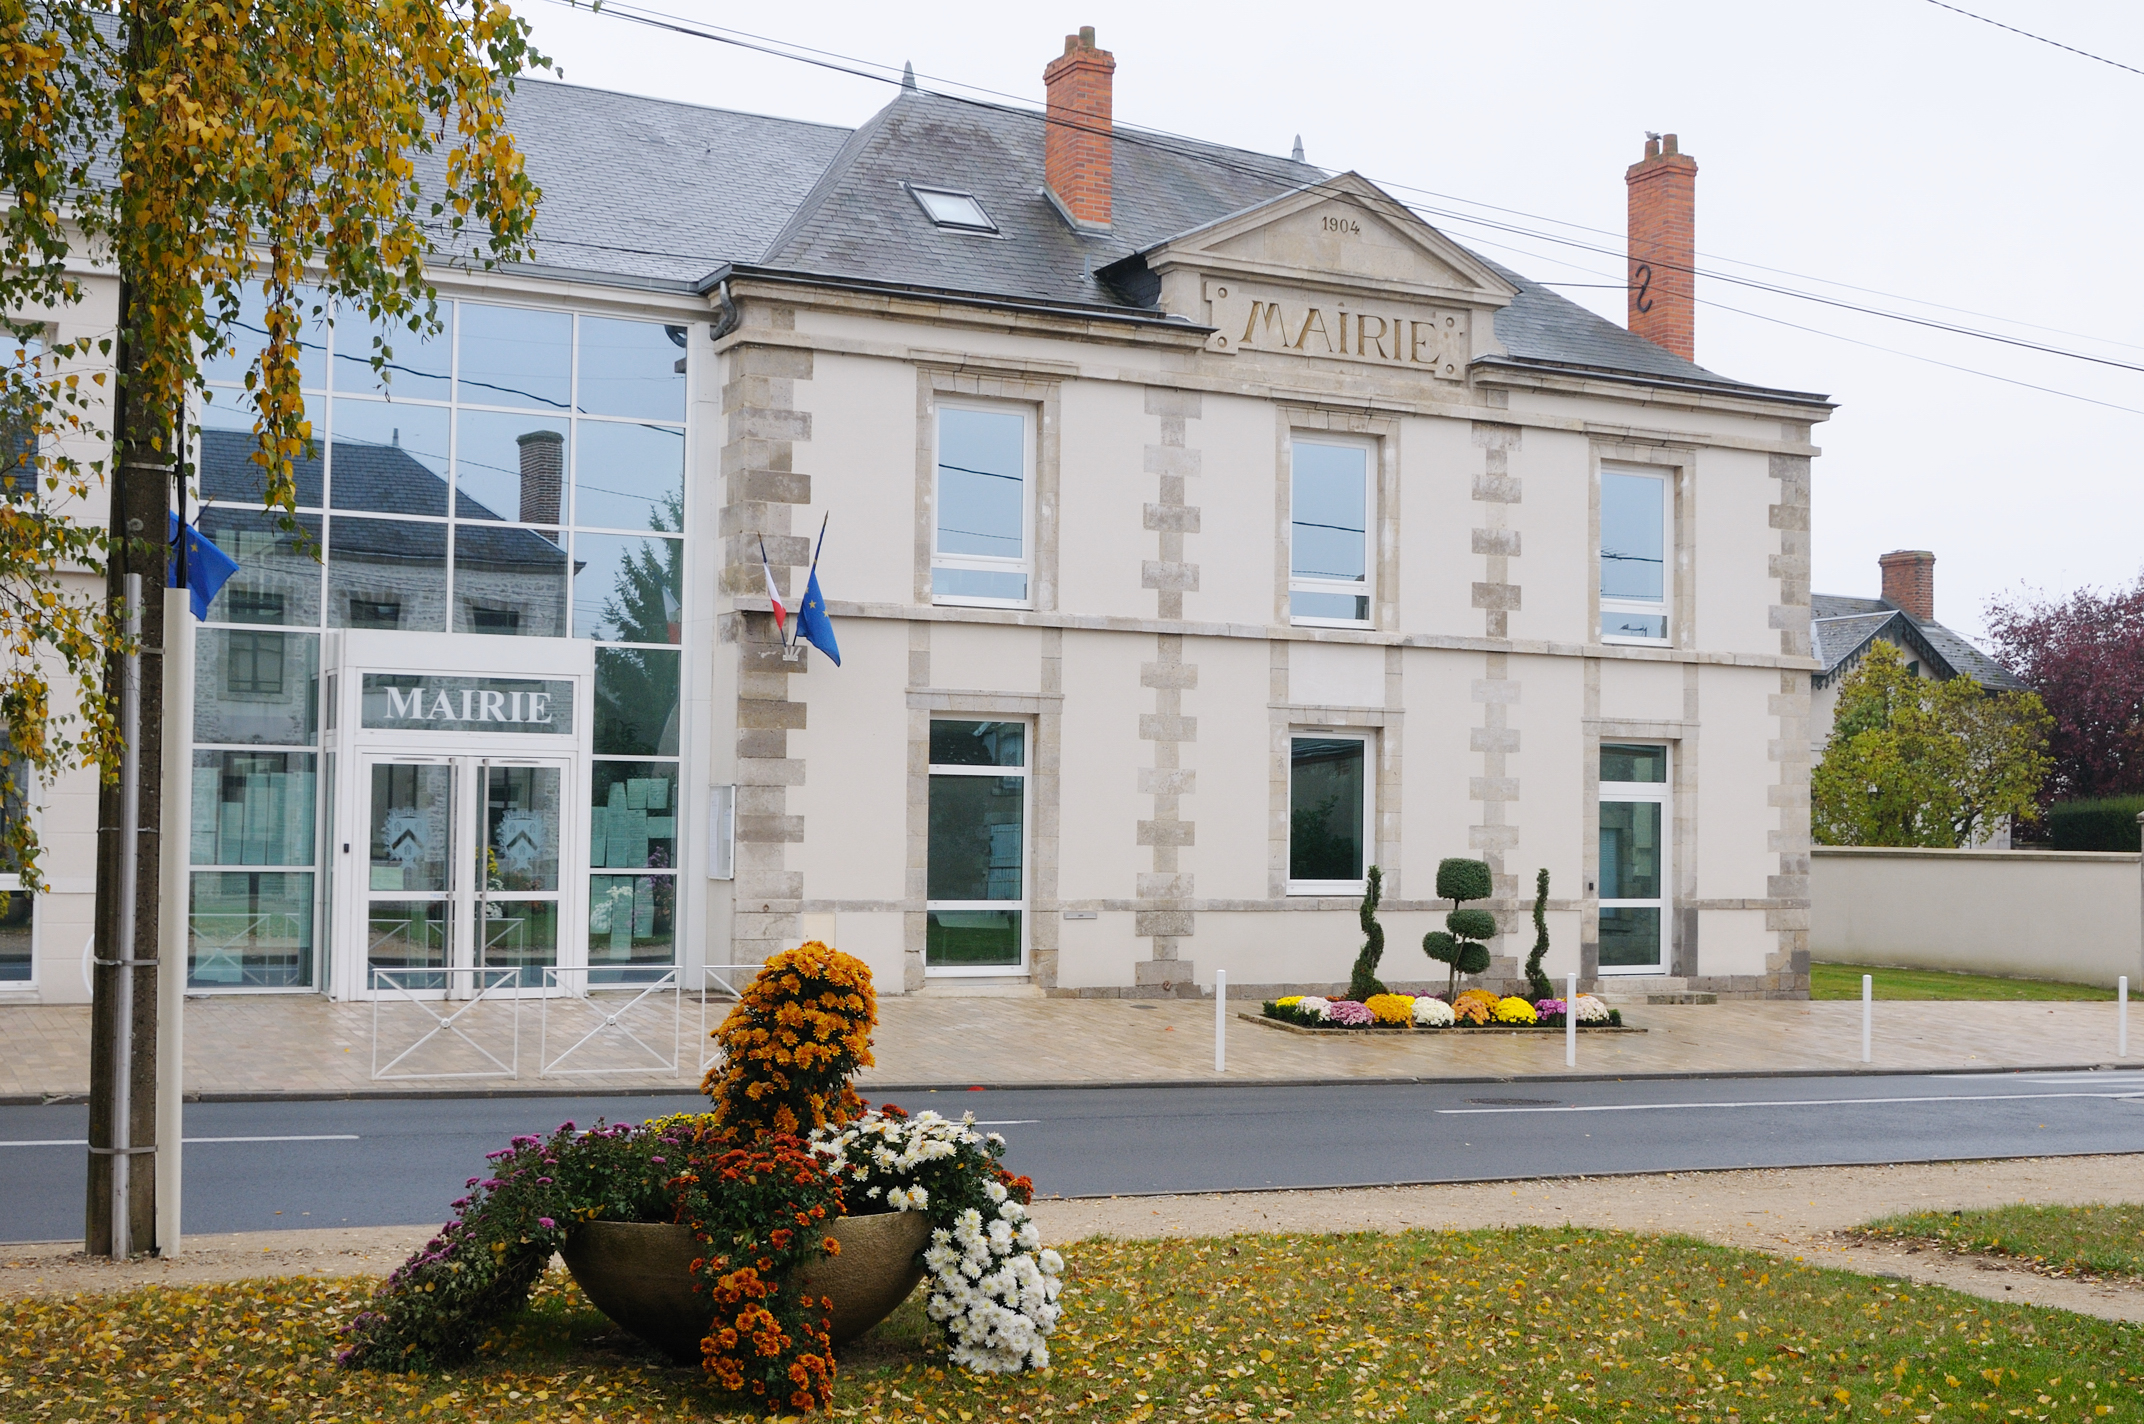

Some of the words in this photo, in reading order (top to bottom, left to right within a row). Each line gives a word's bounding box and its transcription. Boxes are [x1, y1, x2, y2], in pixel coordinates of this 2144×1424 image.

[1321, 216, 1360, 234] 1904
[1240, 300, 1440, 363] MAIRIE
[383, 686, 552, 723] MAIRIE
